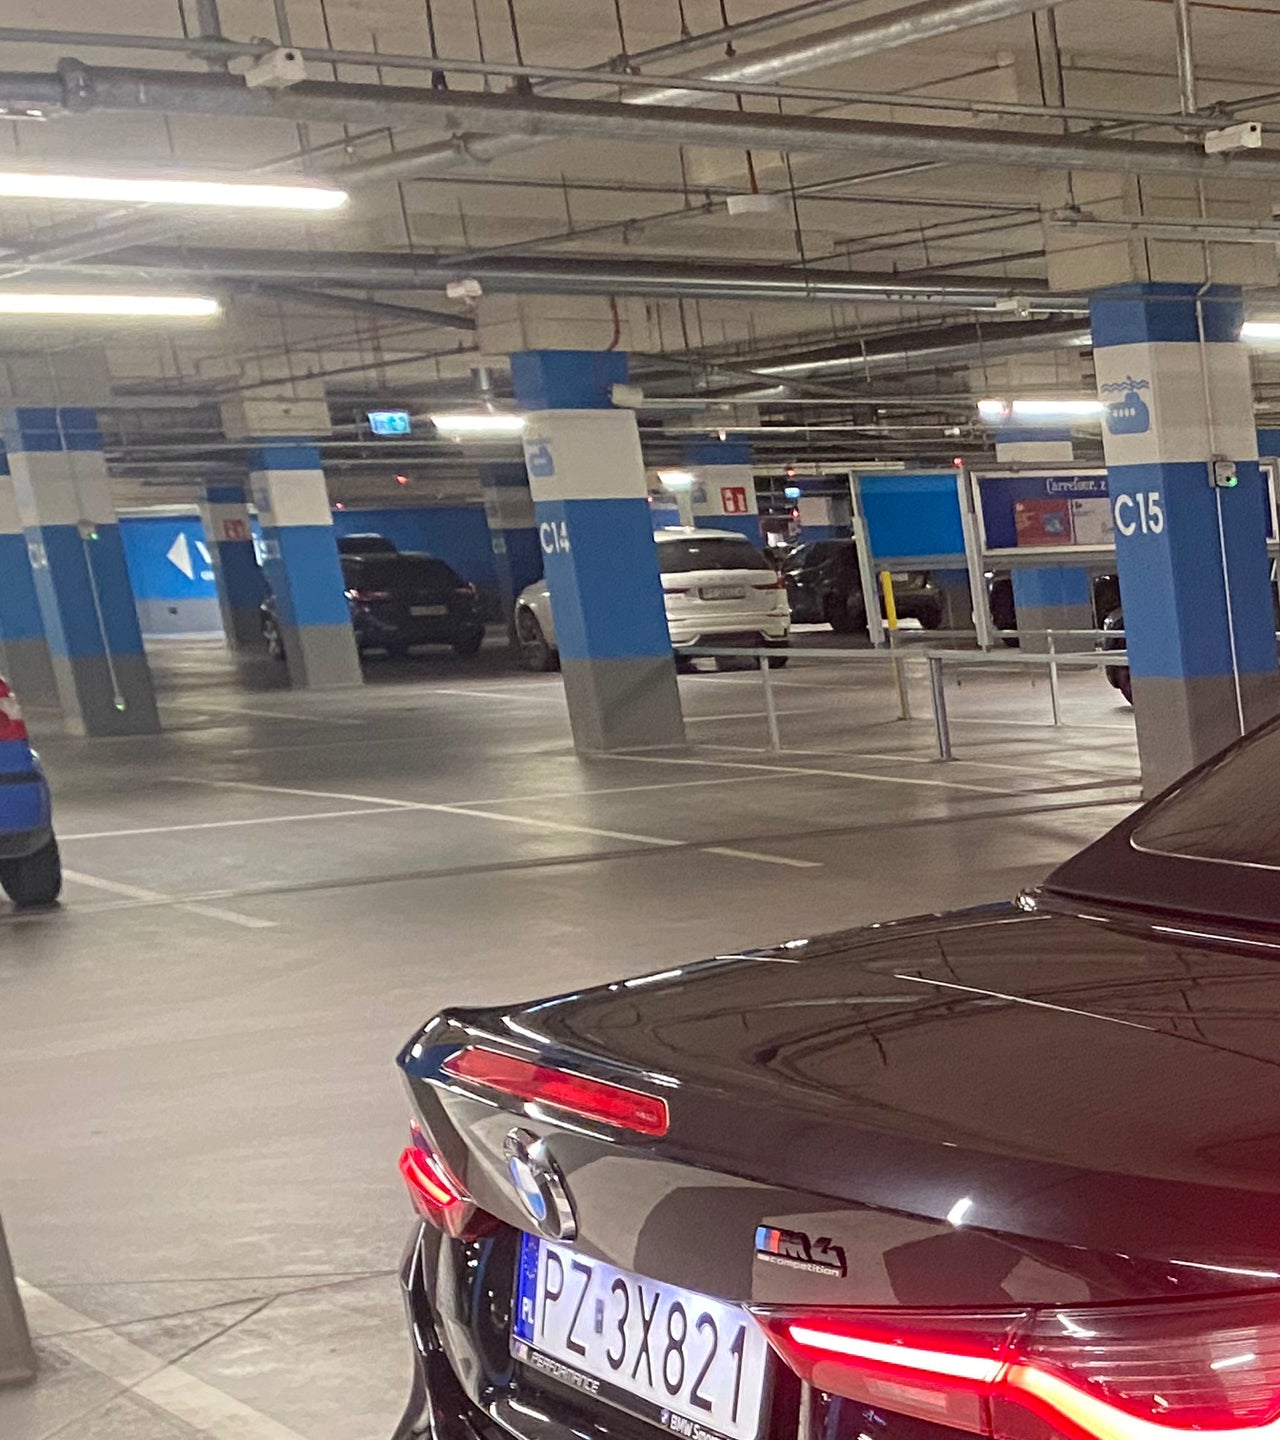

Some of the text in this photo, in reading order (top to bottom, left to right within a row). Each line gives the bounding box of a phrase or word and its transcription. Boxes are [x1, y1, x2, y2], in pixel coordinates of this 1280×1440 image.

[1114, 492, 1164, 537] C15
[540, 522, 571, 554] C14
[770, 1256, 840, 1278] competition
[521, 1296, 535, 1325] PL
[541, 1248, 746, 1424] PZ 3X821
[531, 1351, 600, 1394] PERFORMANCE
[670, 1414, 694, 1438] BMW
